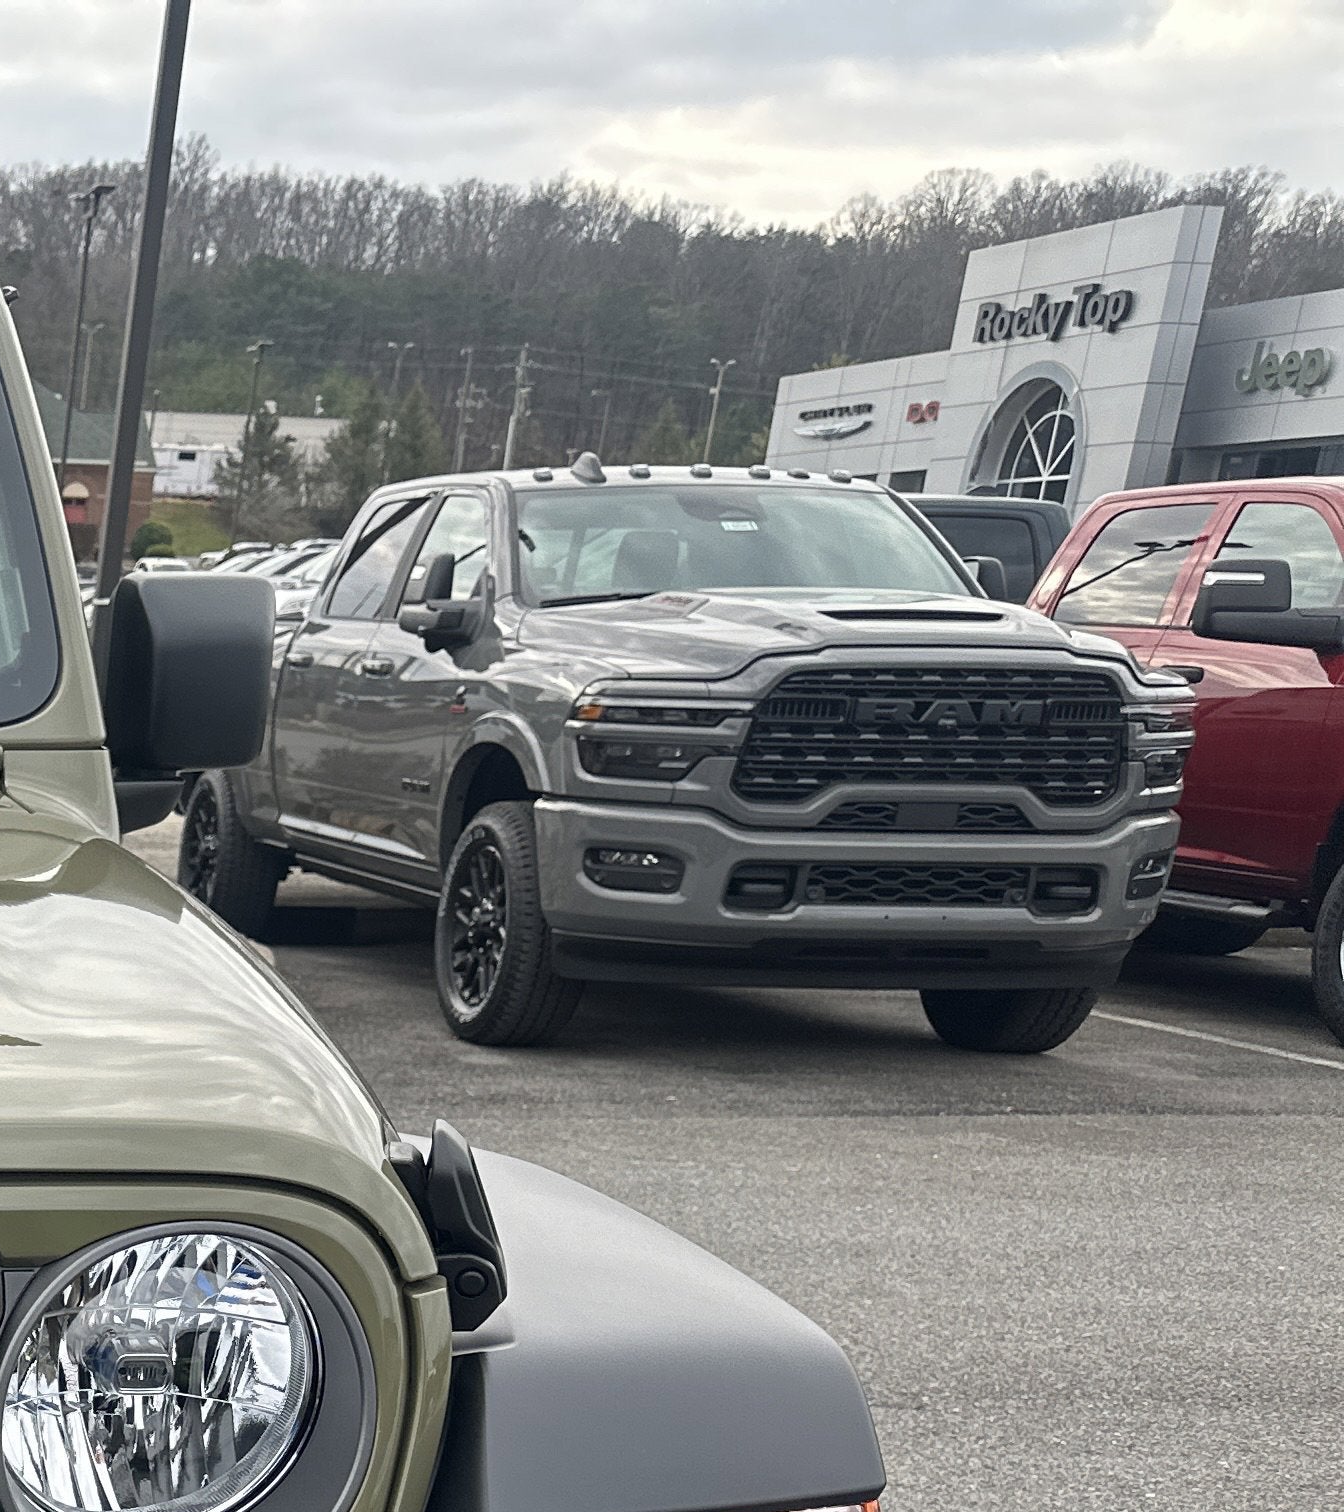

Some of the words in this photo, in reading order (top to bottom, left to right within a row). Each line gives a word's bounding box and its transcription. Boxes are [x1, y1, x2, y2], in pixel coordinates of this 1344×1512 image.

[972, 293, 1074, 343] Rocky
[1072, 283, 1134, 334] Top
[1234, 340, 1332, 398] Jeep
[853, 698, 1045, 726] RAM
